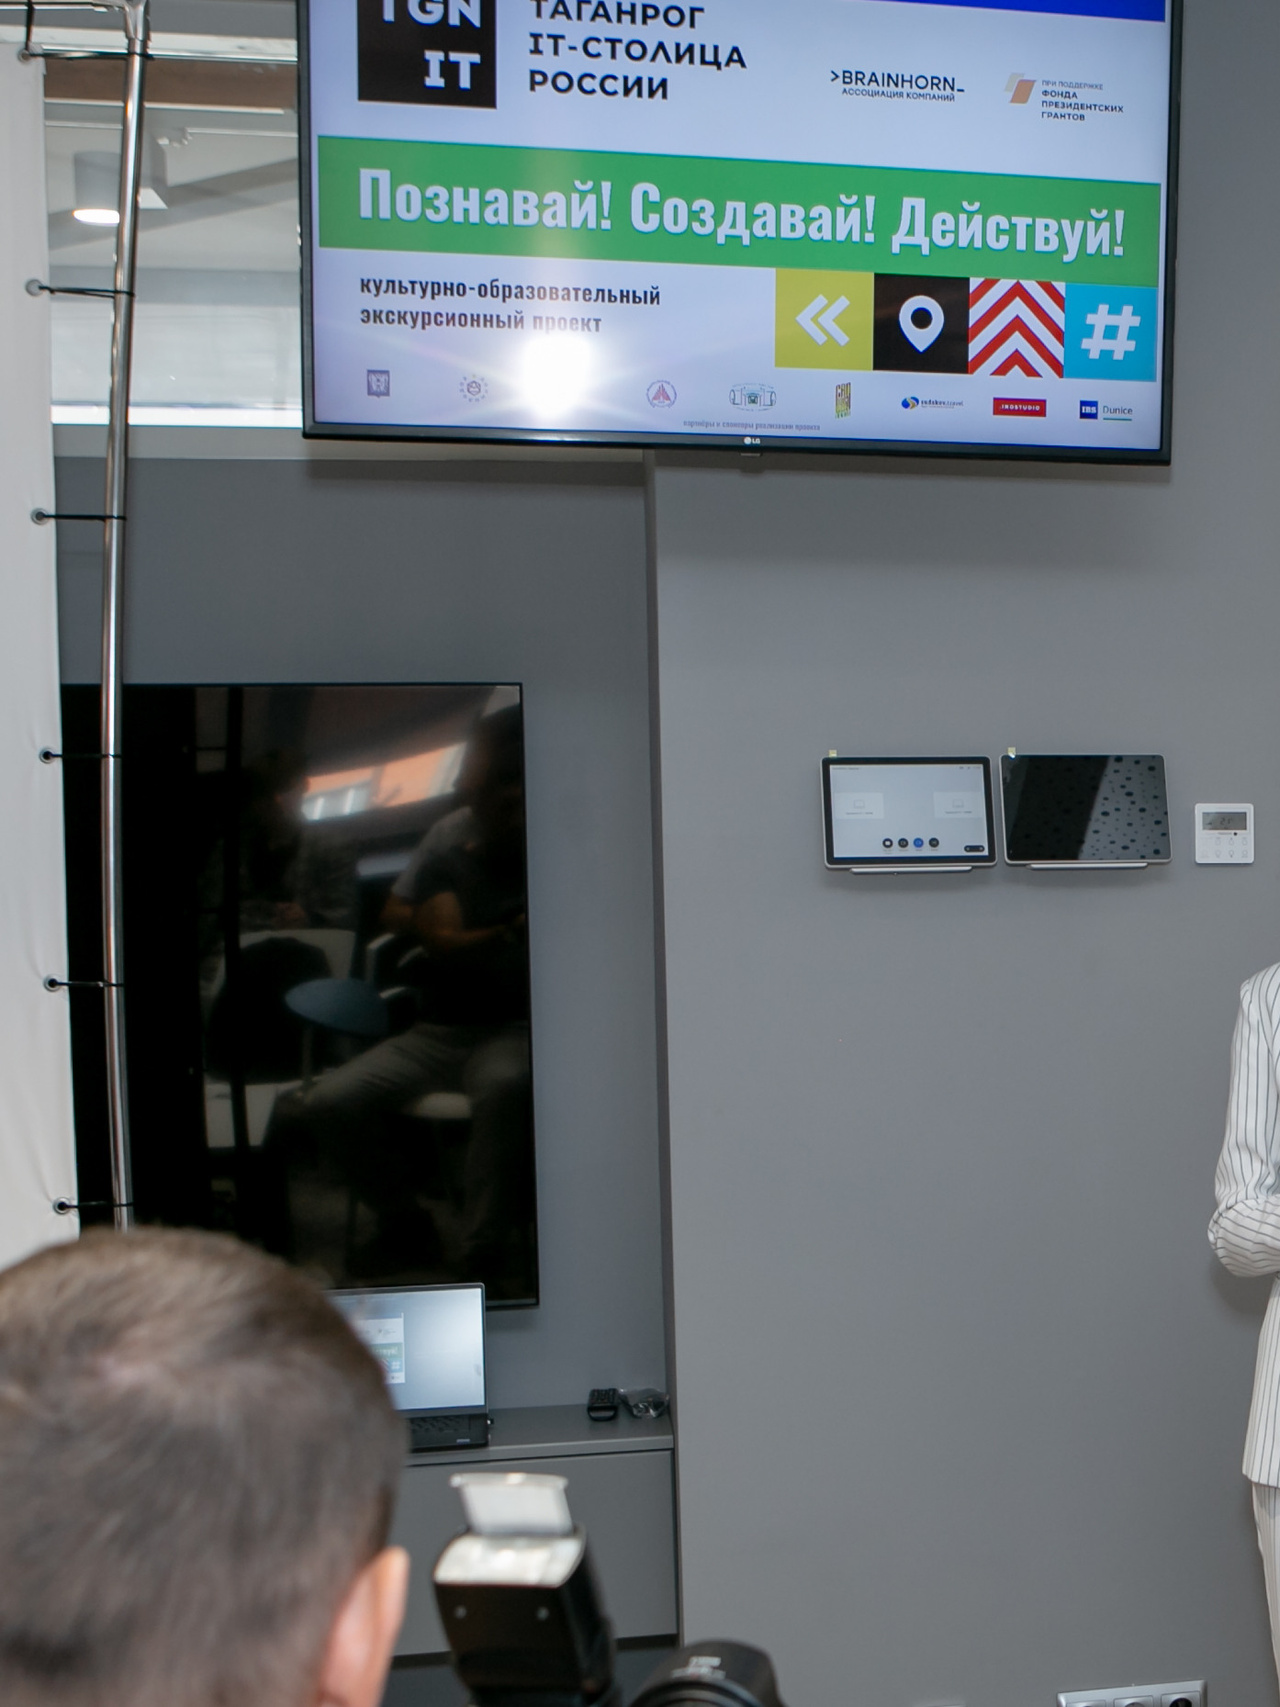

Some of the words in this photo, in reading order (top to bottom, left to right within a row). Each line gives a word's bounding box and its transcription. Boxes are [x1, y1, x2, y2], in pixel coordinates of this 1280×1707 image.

[530, 0, 705, 29] ТАГАНРОГ
[529, 32, 747, 71] IT-СТОЛИЦА
[424, 49, 481, 90] IT
[529, 69, 668, 100] РОССИИ
[842, 87, 904, 99] АССОЦИАЦИЯ
[906, 91, 955, 102] КОМПАНИЙ
[1058, 81, 1104, 90] ПОДДЕРЖКЕ
[1041, 90, 1078, 100] ФОНДА
[1041, 100, 1124, 113] ПРЕЗИДЕНТСКИХ
[1041, 112, 1086, 121] ГРАНТОВ
[359, 168, 612, 230] Познавай!
[631, 182, 876, 247] Создавай!
[891, 197, 1126, 263] Действуй!
[360, 277, 661, 305] культурно-образовательный
[360, 308, 525, 330] экскурсионный
[533, 315, 602, 333] проект
[1102, 405, 1133, 416] Dunice
[752, 437, 761, 445] LG
